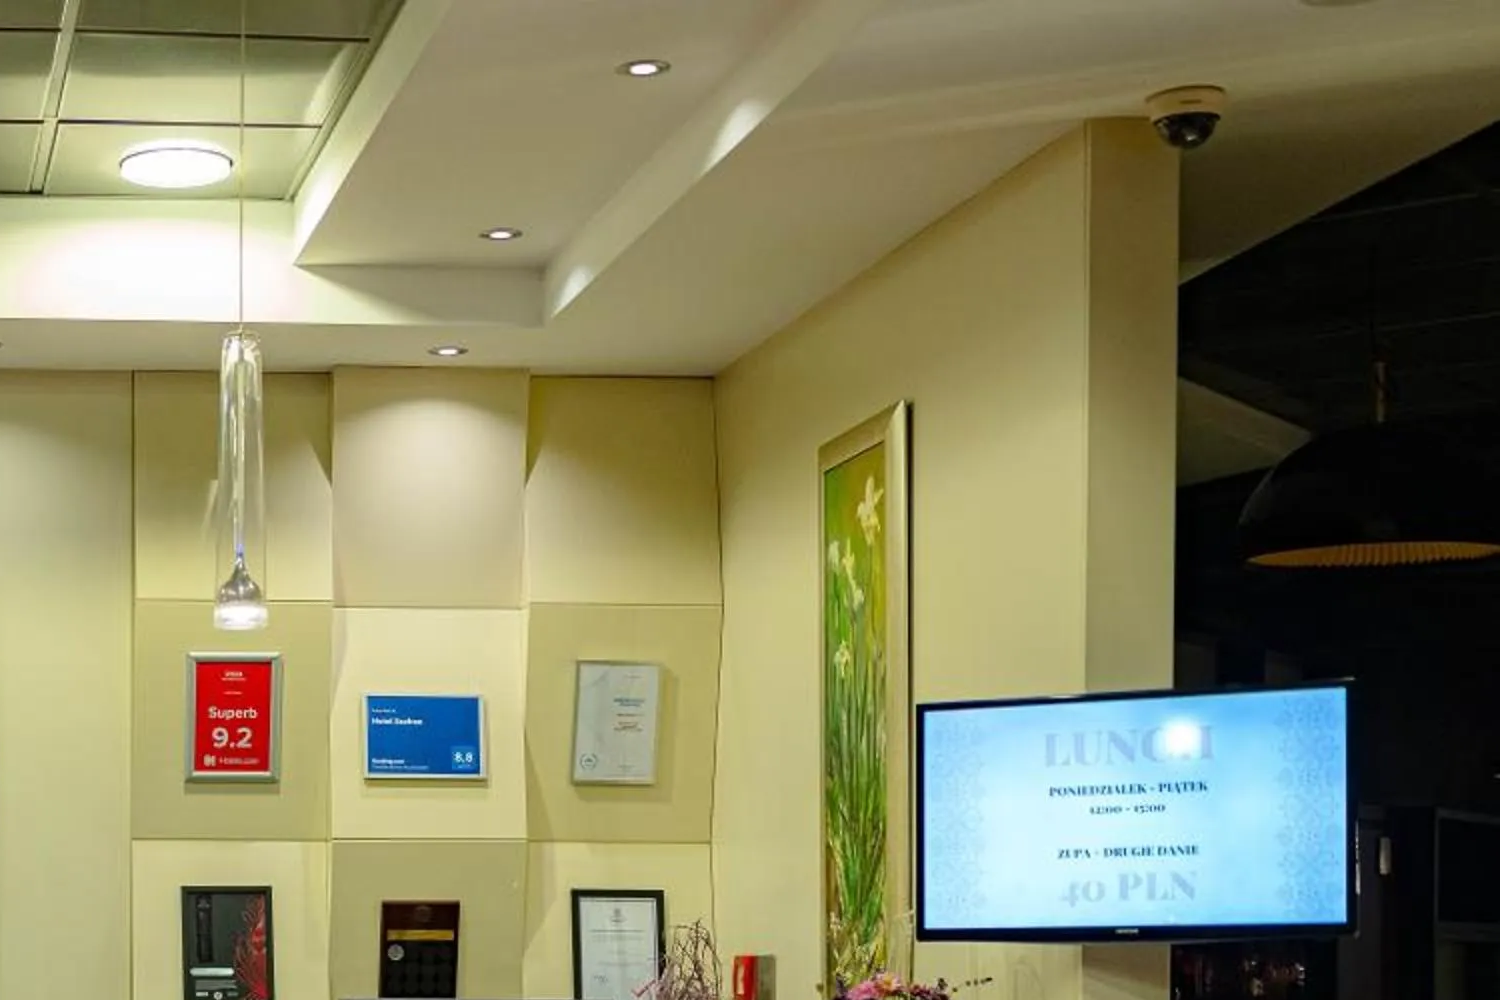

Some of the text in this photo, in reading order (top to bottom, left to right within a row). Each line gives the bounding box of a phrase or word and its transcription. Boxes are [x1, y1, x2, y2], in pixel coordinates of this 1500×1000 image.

[208, 706, 258, 720] Superb
[212, 727, 253, 748] 9.2
[1057, 849, 1091, 859] ZUPA
[1103, 847, 1154, 858] DRUGIE
[1157, 845, 1200, 856] DANIE
[1060, 870, 1198, 908] 40 PLN
